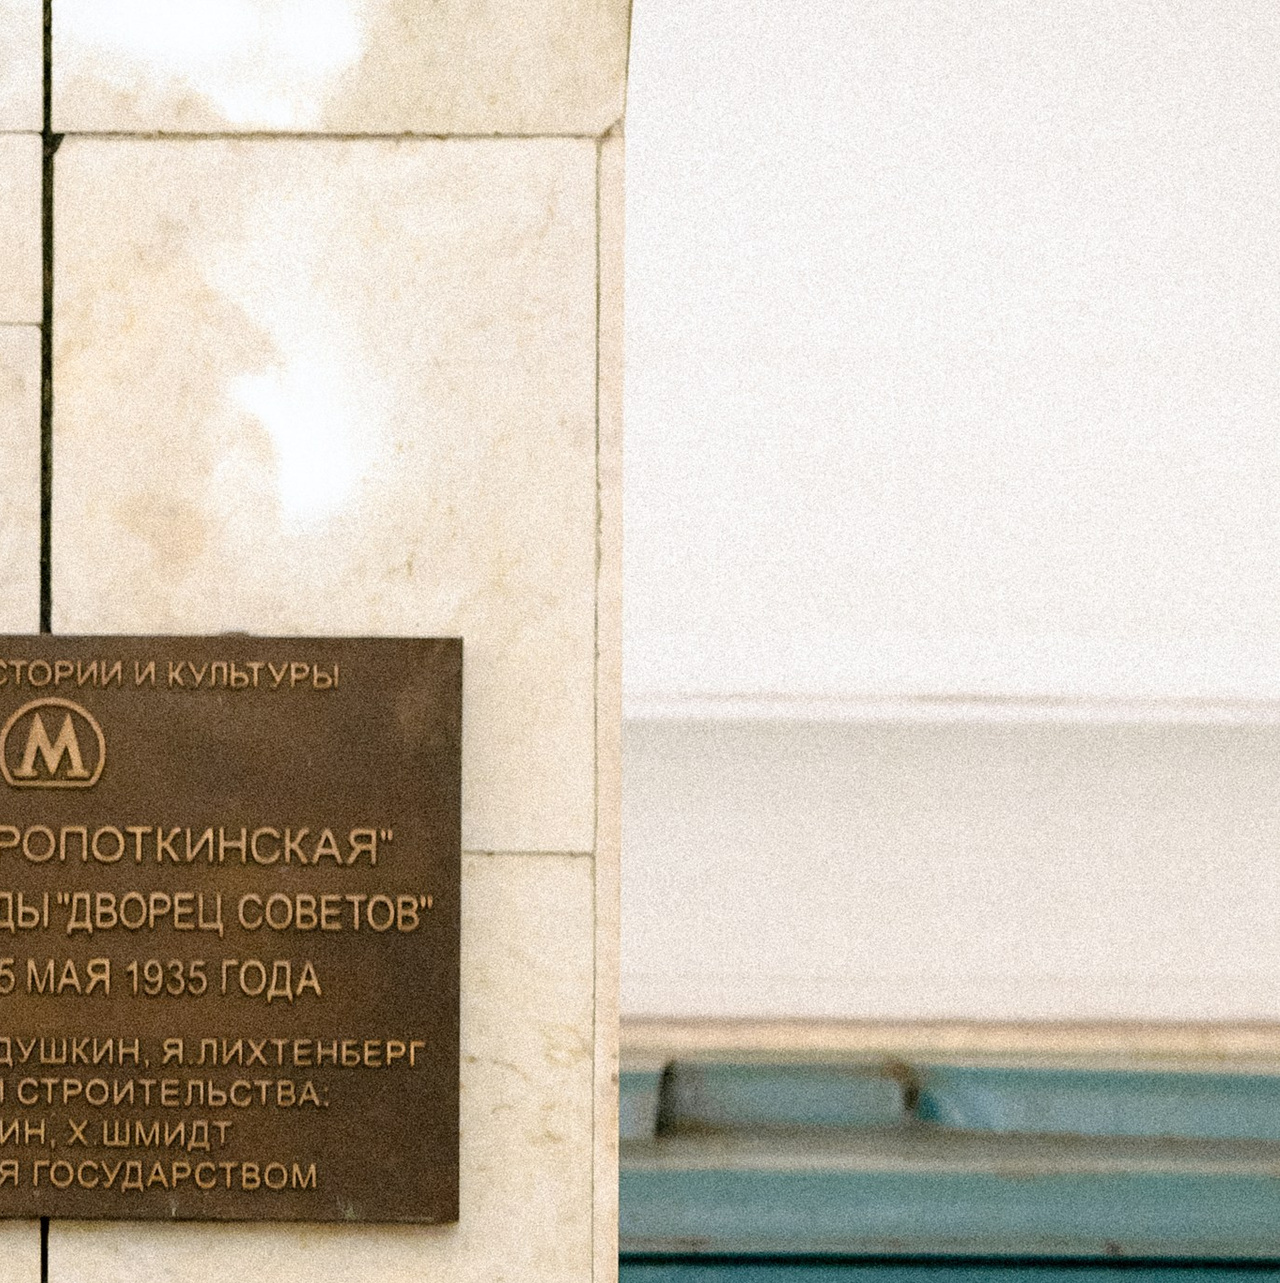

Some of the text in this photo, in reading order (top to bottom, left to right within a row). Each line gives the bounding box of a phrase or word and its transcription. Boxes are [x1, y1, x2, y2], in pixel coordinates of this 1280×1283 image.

[135, 661, 156, 685] И
[168, 661, 339, 688] КУЛЬТУРЫ
[13, 711, 90, 777] М
[56, 890, 224, 936] "ДВОРЕЦ
[237, 892, 433, 932] СОВЕТОВ"
[26, 957, 111, 994] МАЯ
[126, 958, 208, 995] 1935
[221, 958, 322, 1001] ГОДА
[32, 1159, 317, 1191] ГОСУДАРСТВОМ
